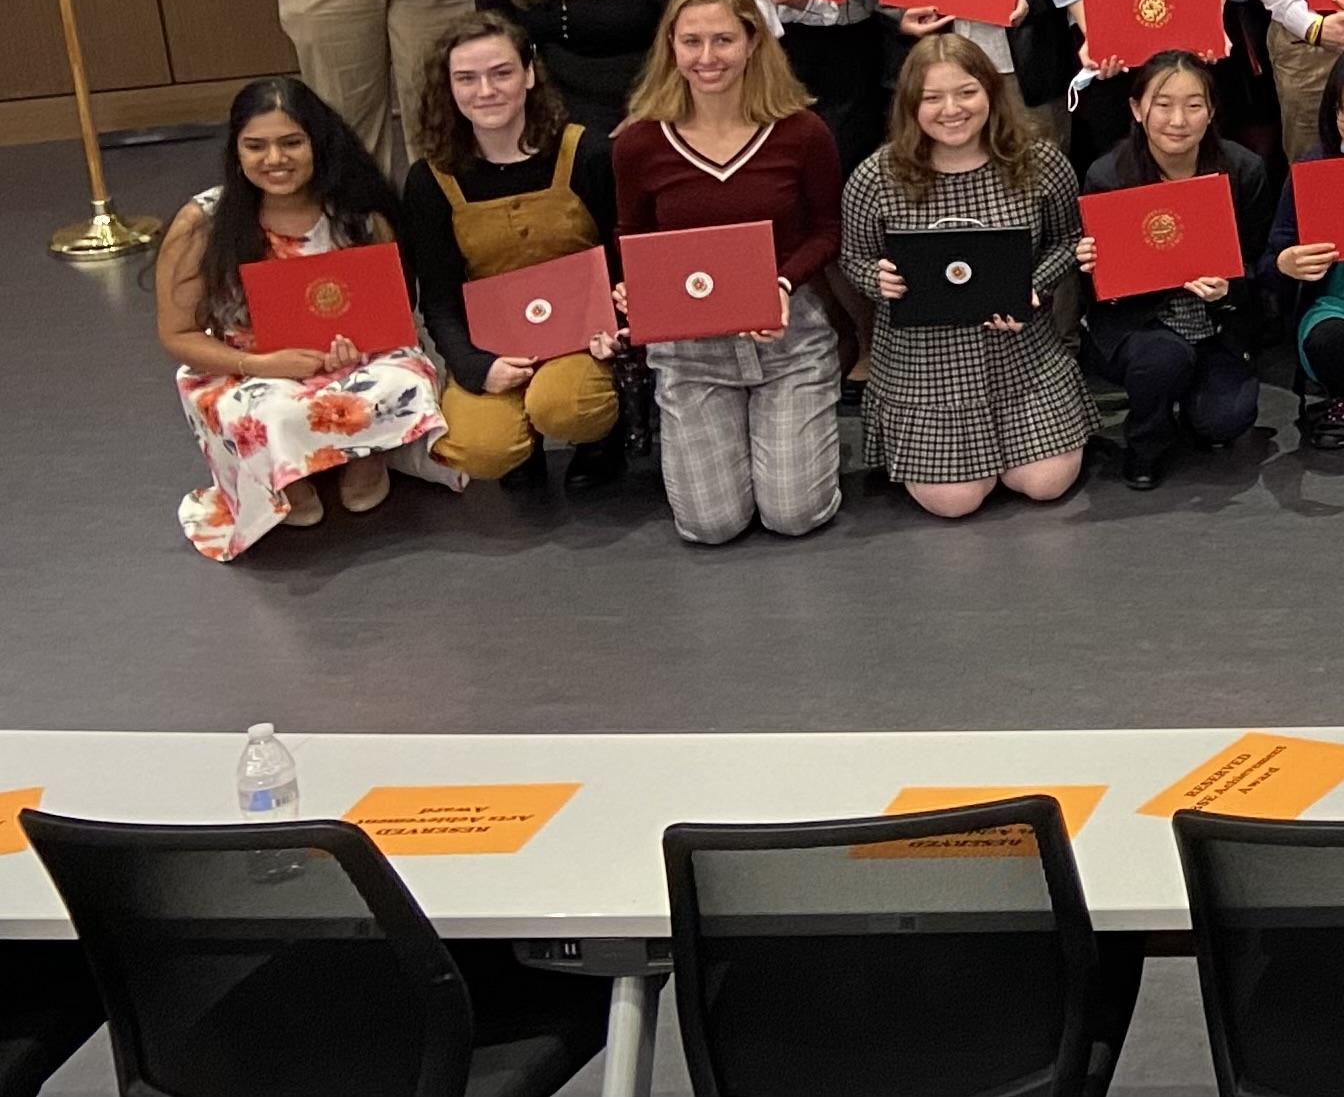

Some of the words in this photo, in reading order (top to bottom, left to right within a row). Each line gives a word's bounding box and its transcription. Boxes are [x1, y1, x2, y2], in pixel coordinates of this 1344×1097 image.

[1183, 752, 1252, 799] RESERVED
[1214, 743, 1288, 795] Achievement
[1237, 766, 1281, 796] Award
[354, 815, 483, 826] Achievement
[416, 806, 491, 815] Award
[375, 825, 492, 836] RESERVED
